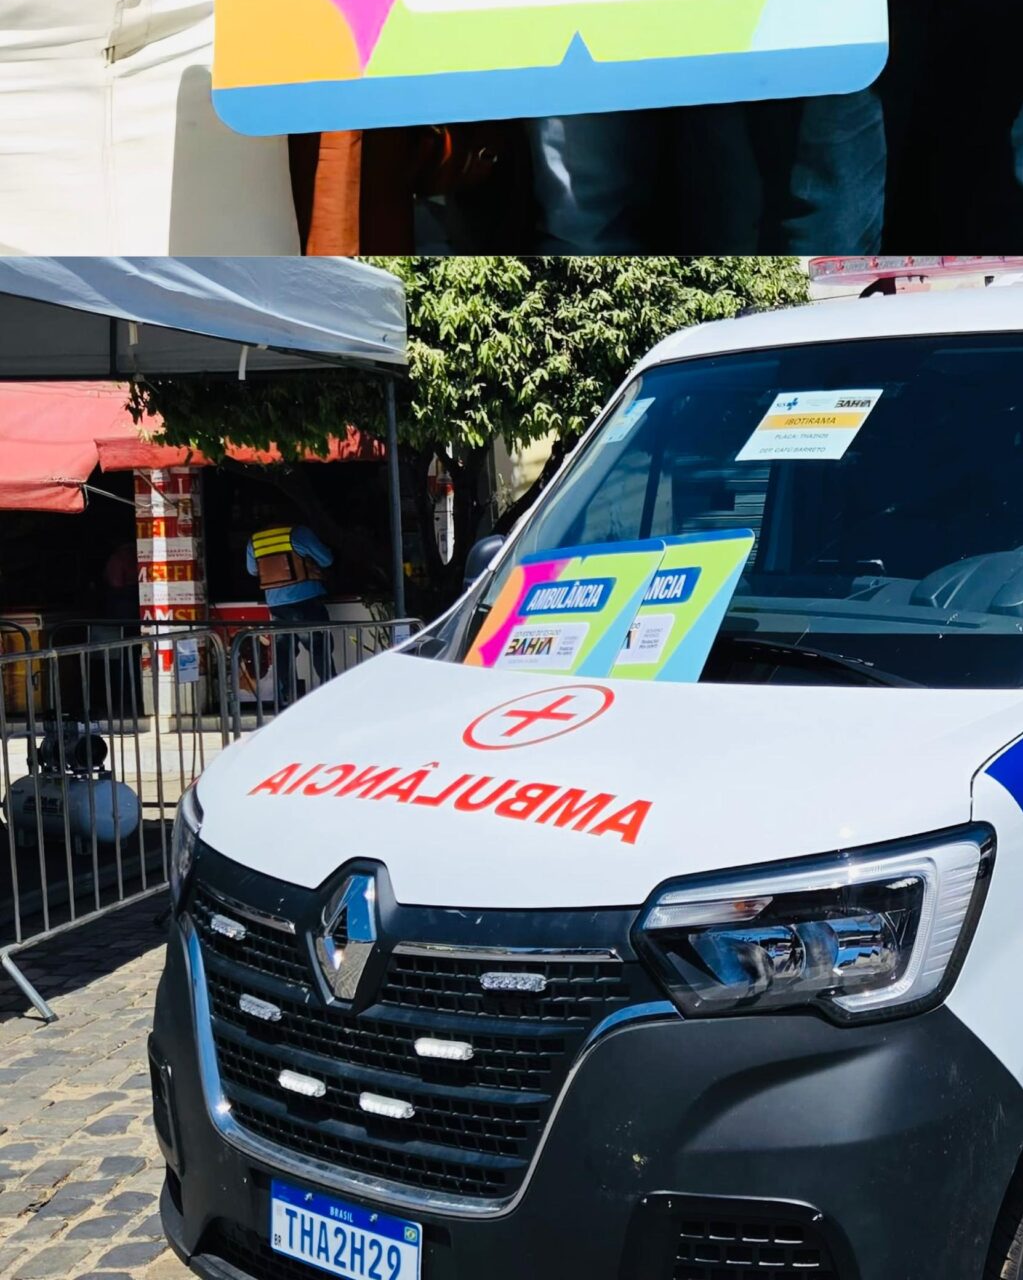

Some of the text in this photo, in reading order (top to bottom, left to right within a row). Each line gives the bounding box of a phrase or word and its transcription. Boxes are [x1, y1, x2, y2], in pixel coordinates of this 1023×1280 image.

[526, 581, 604, 611] AMBULÂNCIA
[505, 637, 556, 657] BAHIA
[329, 1206, 354, 1223] BRASIL
[285, 1208, 402, 1280] THA2H29
